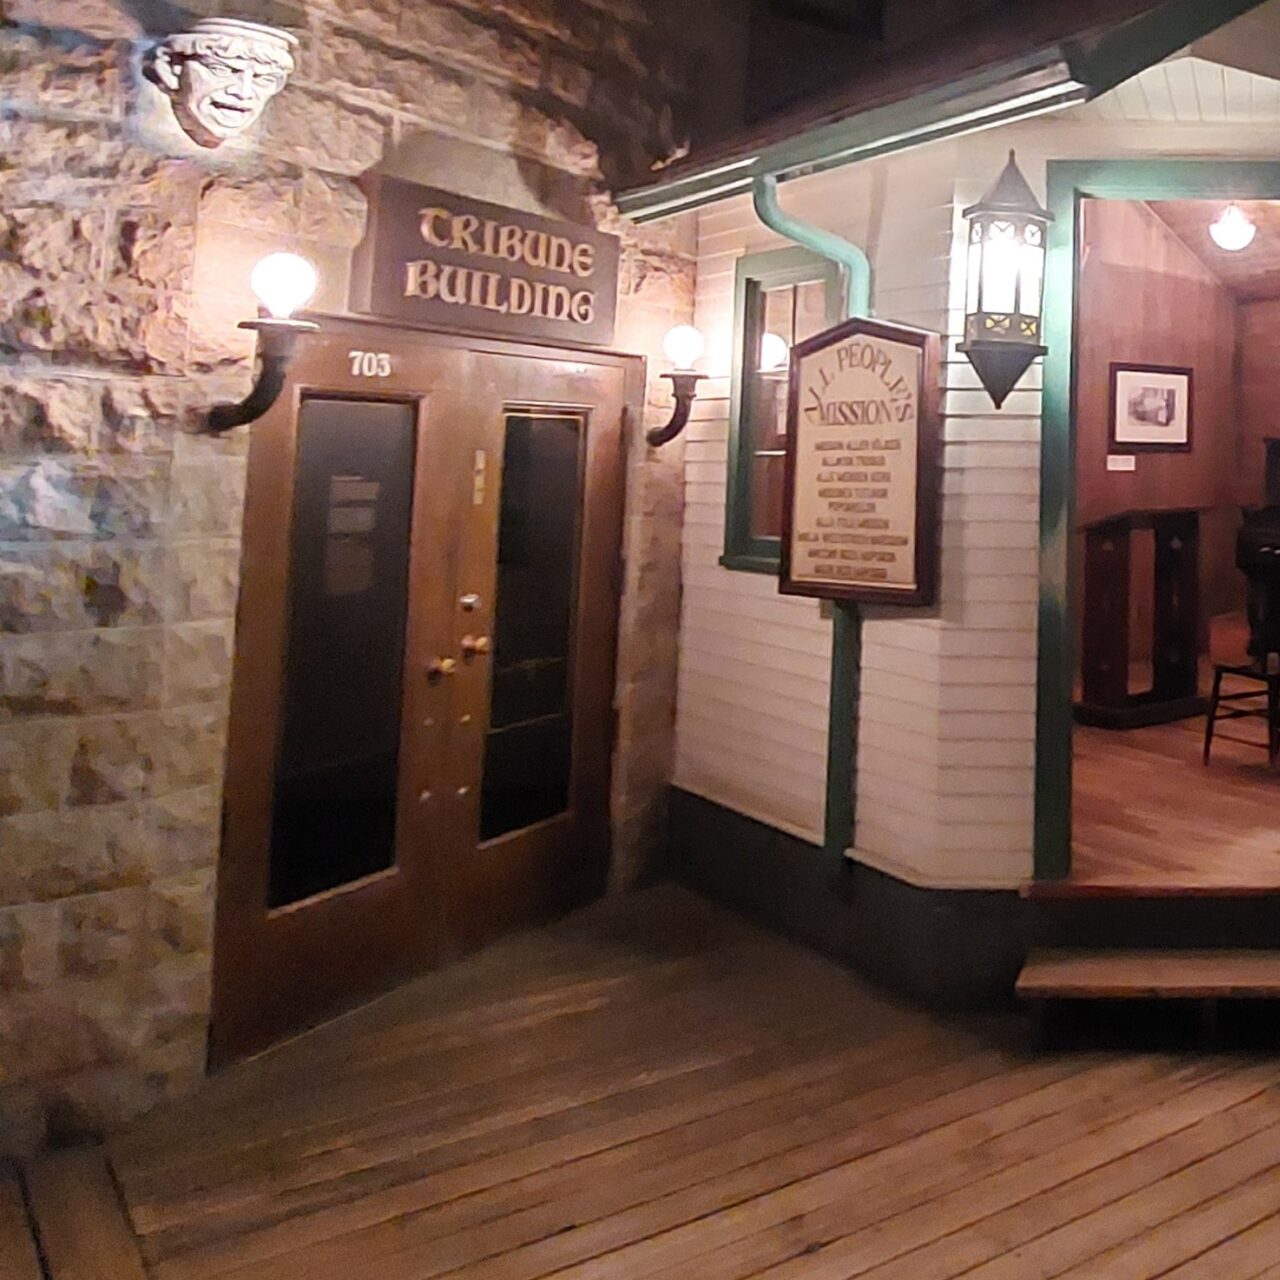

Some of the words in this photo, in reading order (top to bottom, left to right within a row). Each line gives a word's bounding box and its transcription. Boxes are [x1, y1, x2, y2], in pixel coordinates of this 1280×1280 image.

[418, 207, 595, 277] TRIBUNE
[403, 259, 595, 325] BUILDING
[349, 351, 391, 377] 703
